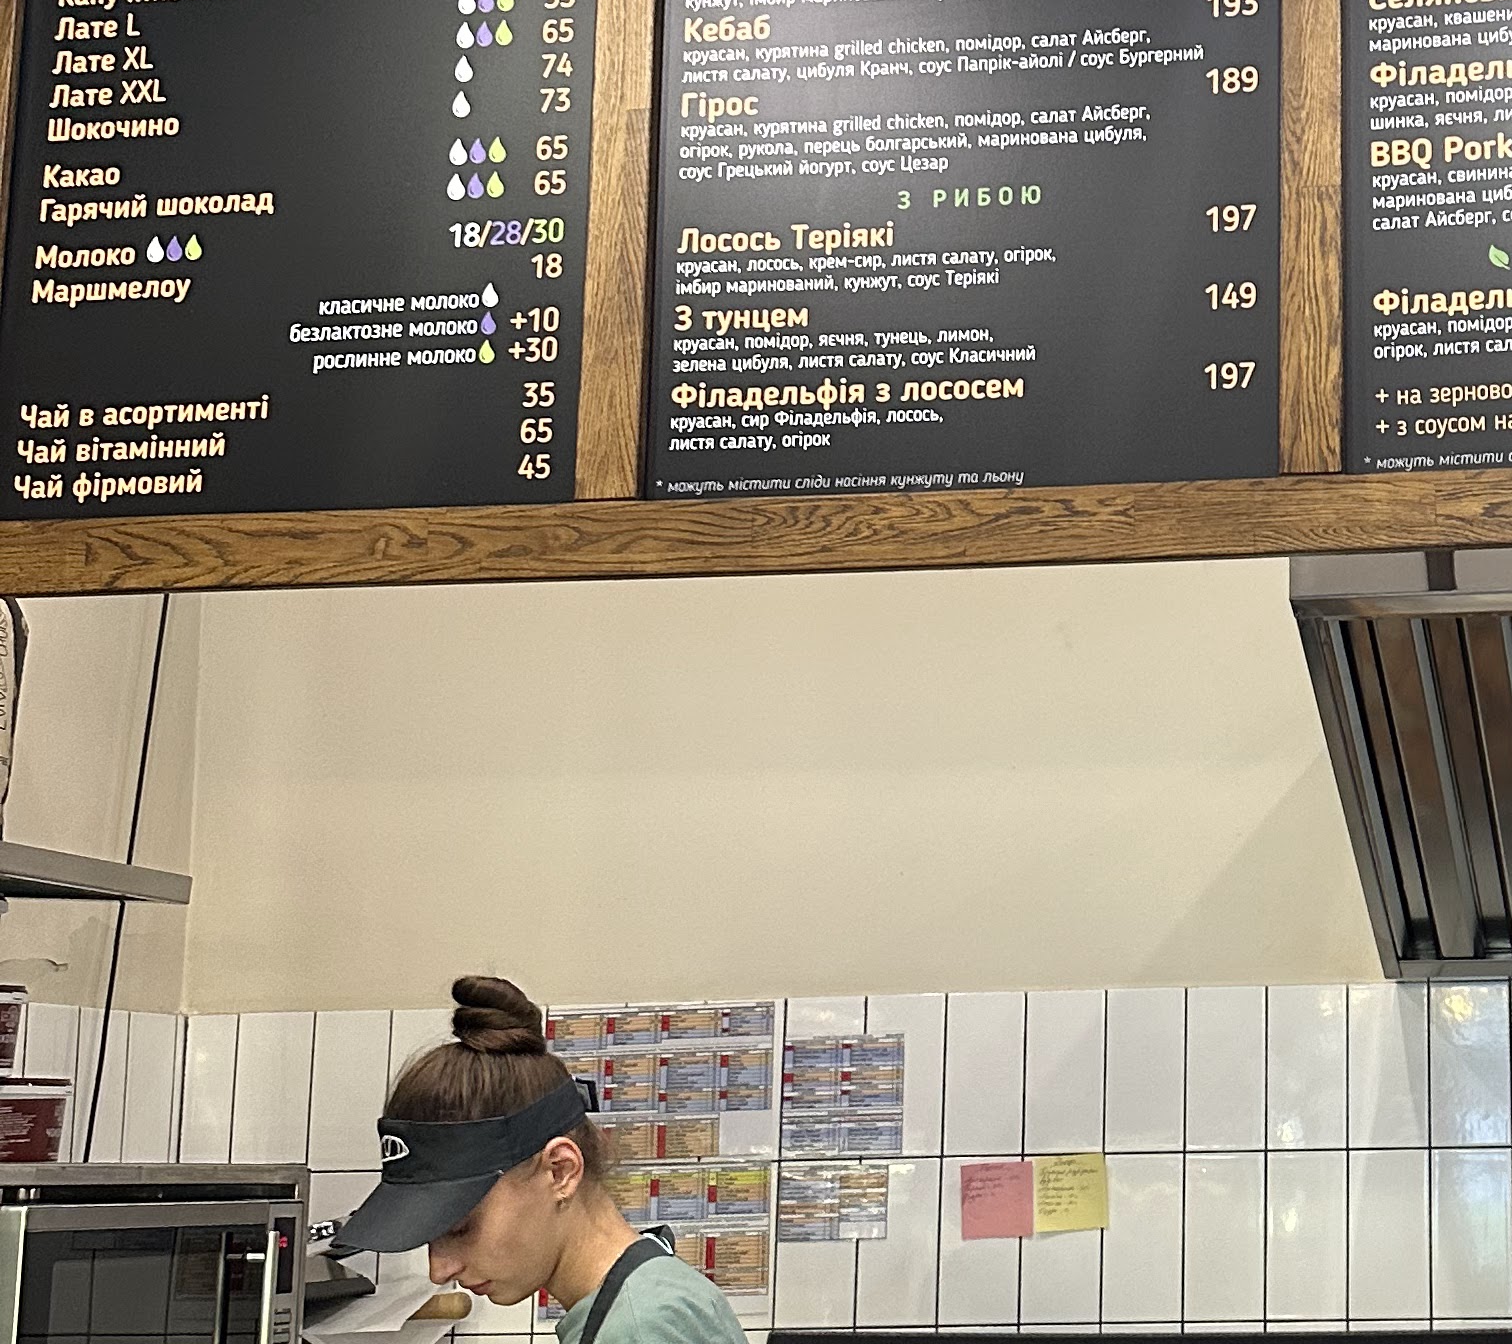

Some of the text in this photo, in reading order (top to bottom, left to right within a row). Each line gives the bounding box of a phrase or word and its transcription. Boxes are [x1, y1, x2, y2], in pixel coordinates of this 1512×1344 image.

[684, 14, 770, 44] Кебаб
[48, 118, 179, 141] Шокочино
[537, 135, 568, 160] 65
[1371, 138, 1433, 169] BBQ
[535, 170, 567, 195] 65
[40, 193, 274, 227] Гарячий шоколад
[897, 185, 1041, 210] З РИБОЮ
[449, 217, 565, 248] 18/28/30
[1373, 216, 1419, 230] салат
[1425, 209, 1497, 227] Айсберг,
[35, 245, 135, 269] Молоко
[532, 254, 563, 278] 18
[32, 279, 191, 308] Маршмелоу
[319, 294, 479, 315] класичне молоко
[1206, 282, 1257, 309] 149
[510, 307, 559, 332] +10
[674, 304, 809, 335] З тунцем
[509, 336, 557, 362] +30
[1205, 362, 1255, 389] 197
[523, 382, 554, 407] 35
[672, 378, 1023, 413] Філадельфія з лососем
[21, 395, 269, 430] Чай в асортименті
[518, 454, 550, 479] 45
[15, 469, 202, 503] Чай фірмовий
